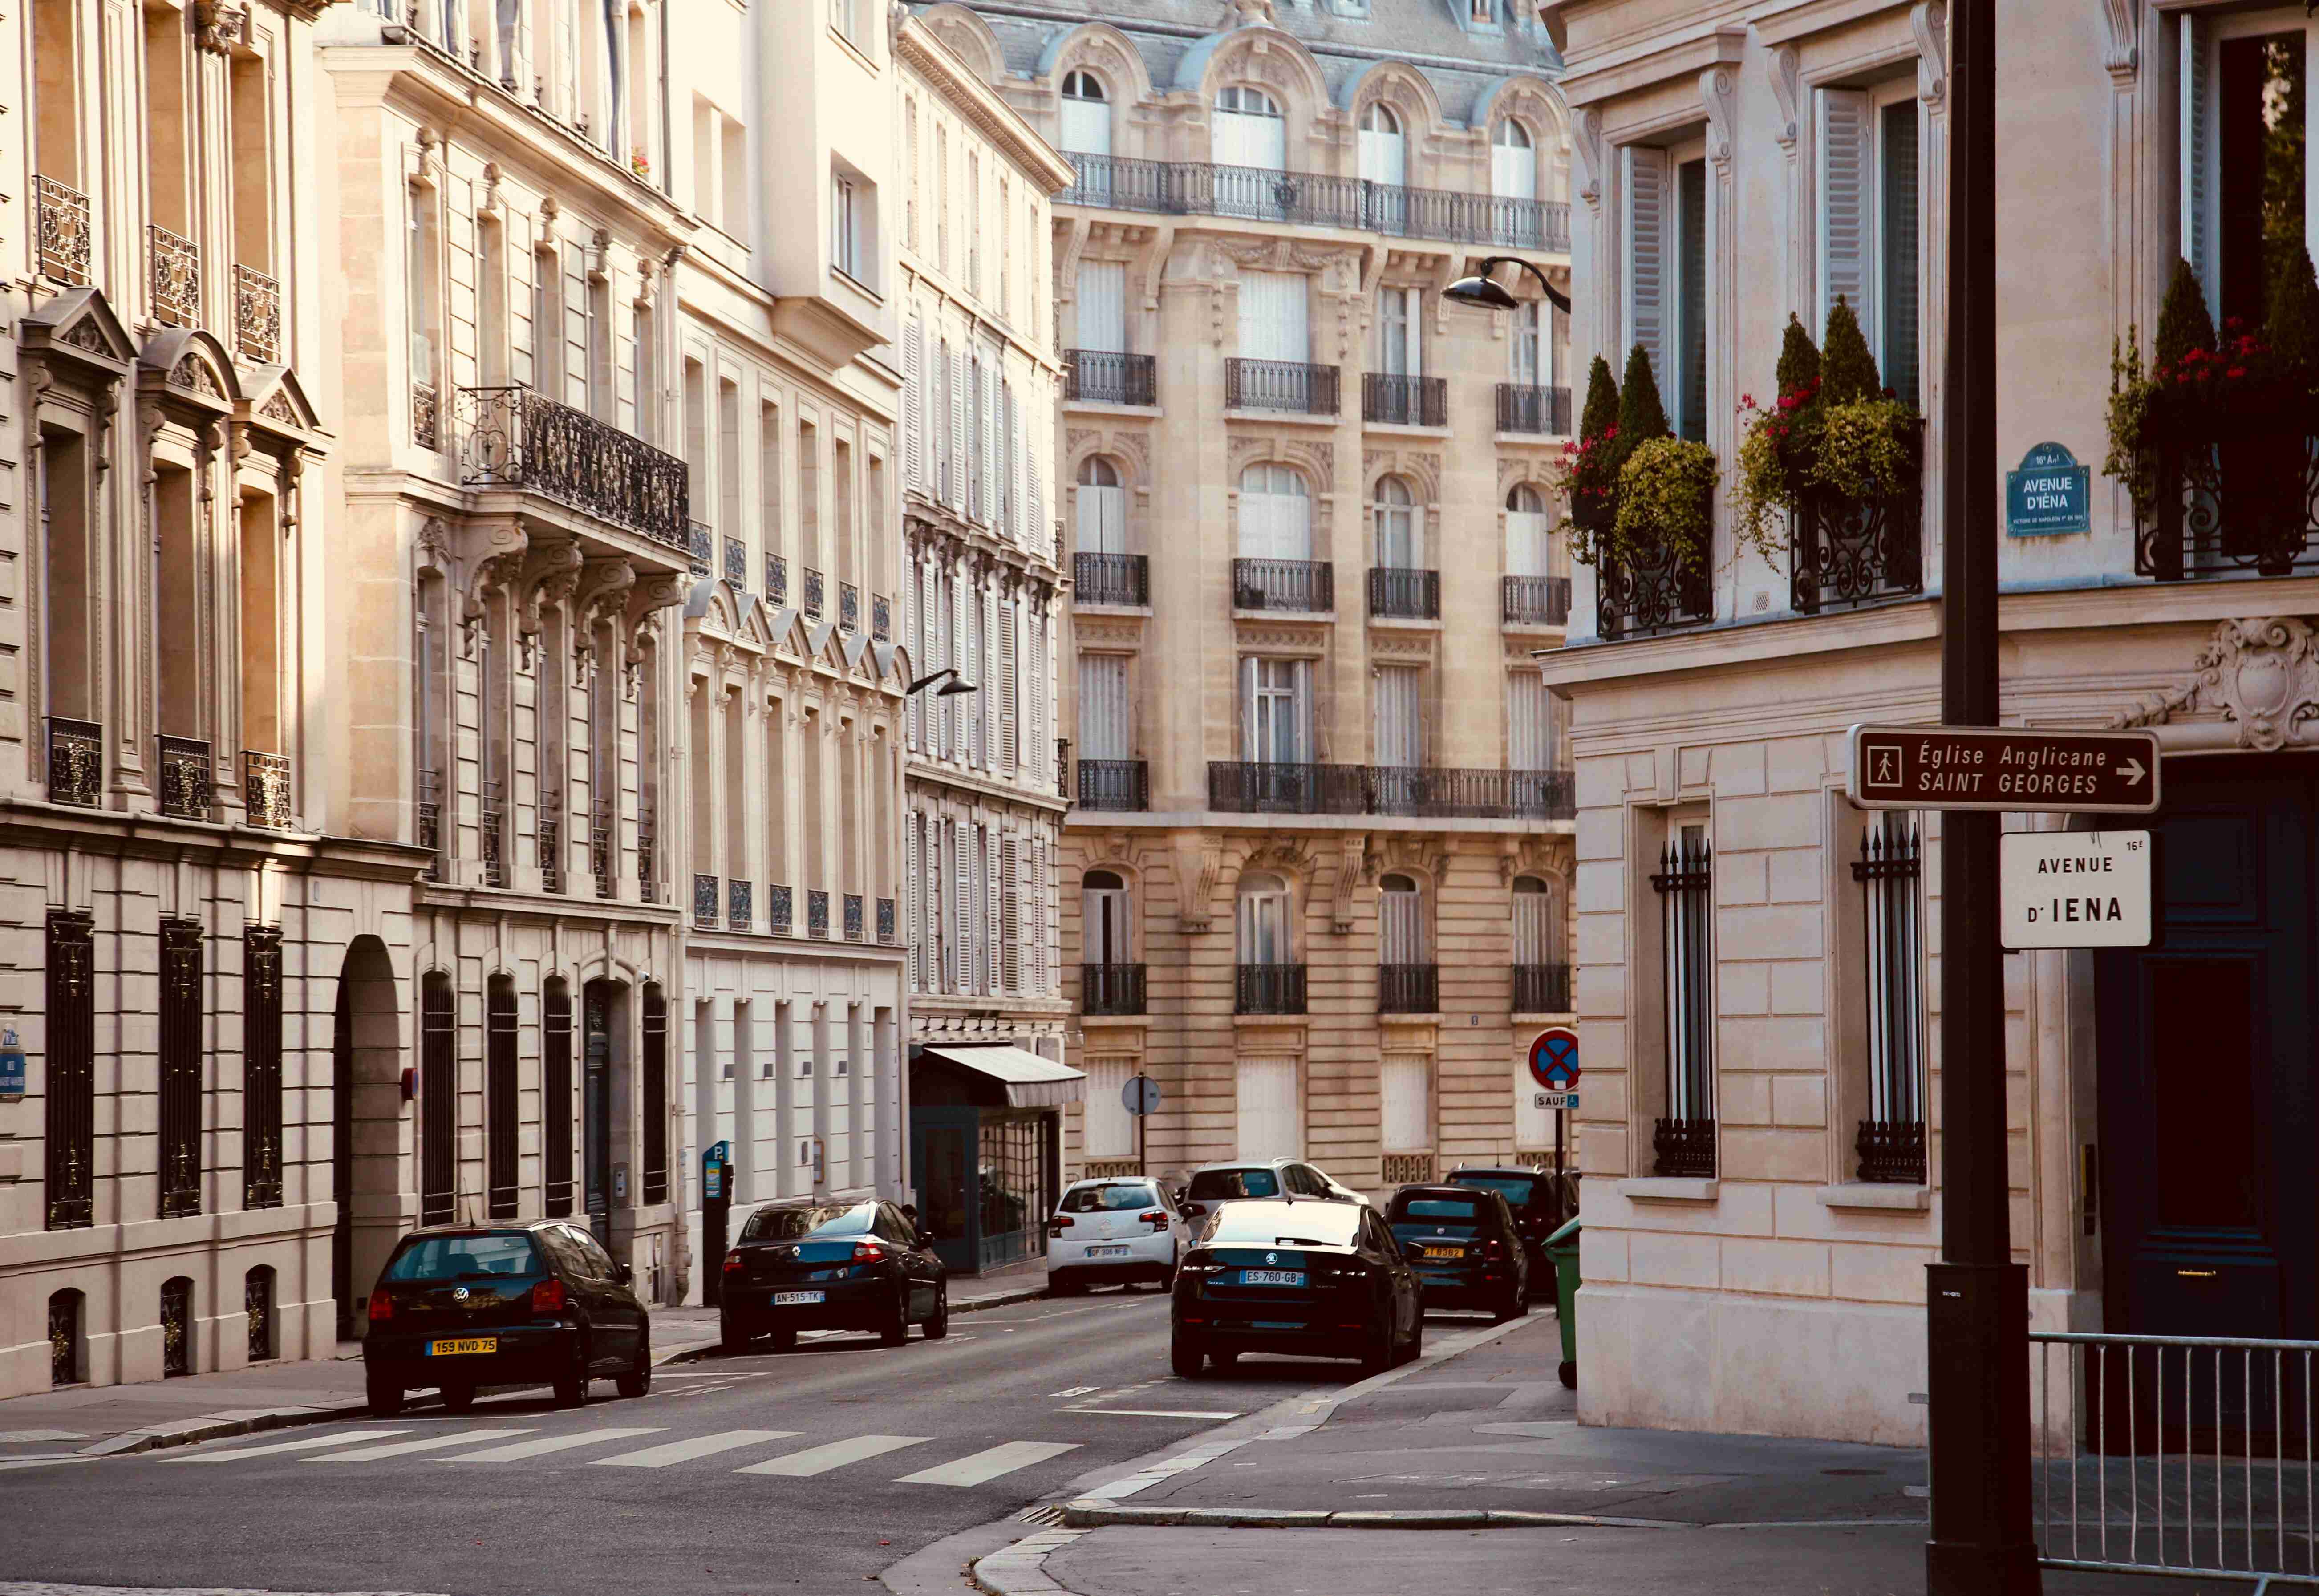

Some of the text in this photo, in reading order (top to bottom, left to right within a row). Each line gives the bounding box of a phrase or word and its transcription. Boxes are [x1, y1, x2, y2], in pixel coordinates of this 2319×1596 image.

[2024, 477, 2072, 493] AVENUE
[1919, 740, 2106, 770] Église Anglicane
[1919, 772, 2097, 794] SAINT GEORGES
[2038, 857, 2112, 874] AVENUE
[1538, 1097, 1565, 1106] SAUF
[714, 1146, 723, 1159] P
[1248, 1272, 1297, 1282] ES-760-GB
[777, 1292, 819, 1302] AN-515-TK
[436, 1340, 495, 1353] 159 NVD 75
